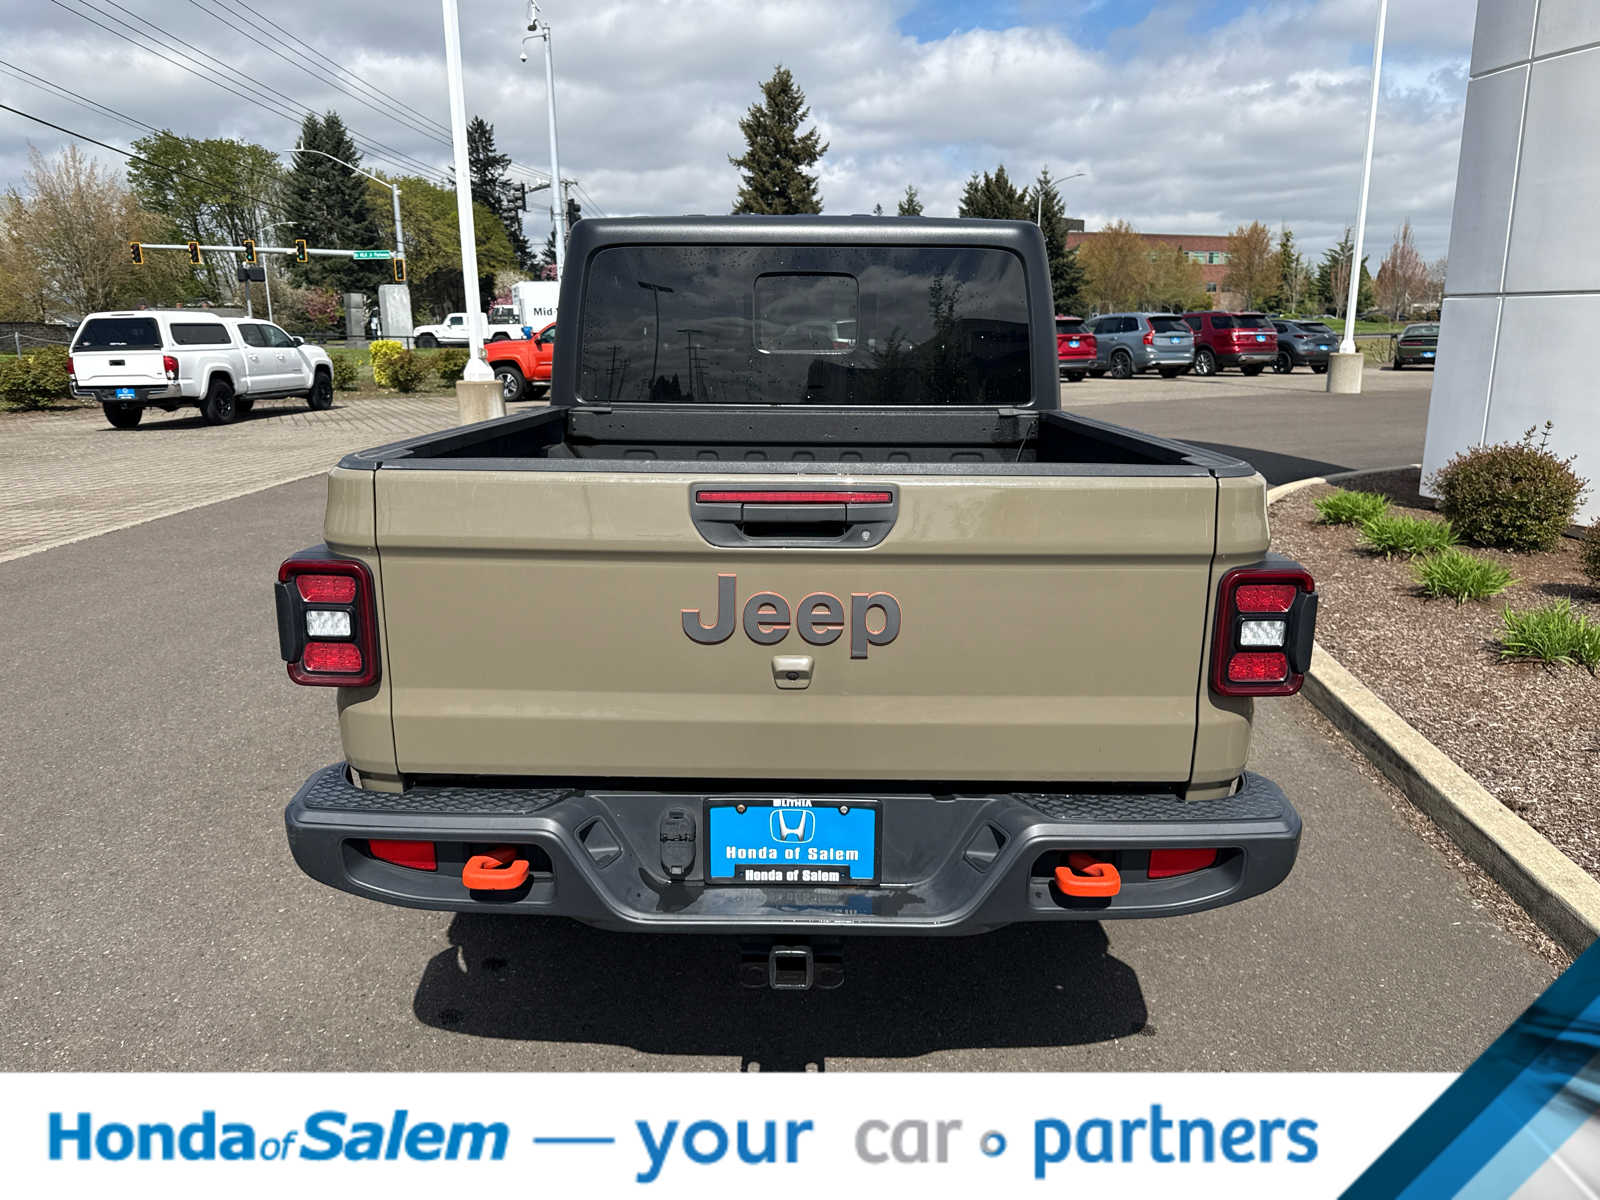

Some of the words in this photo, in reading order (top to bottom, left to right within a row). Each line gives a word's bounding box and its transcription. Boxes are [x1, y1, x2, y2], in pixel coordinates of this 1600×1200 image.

[681, 573, 903, 660] Jeep
[726, 846, 778, 860] Honda
[785, 847, 801, 859] of
[808, 848, 859, 860] Salem
[745, 870, 783, 881] Honda
[787, 870, 799, 881] of
[802, 870, 840, 882] Salem
